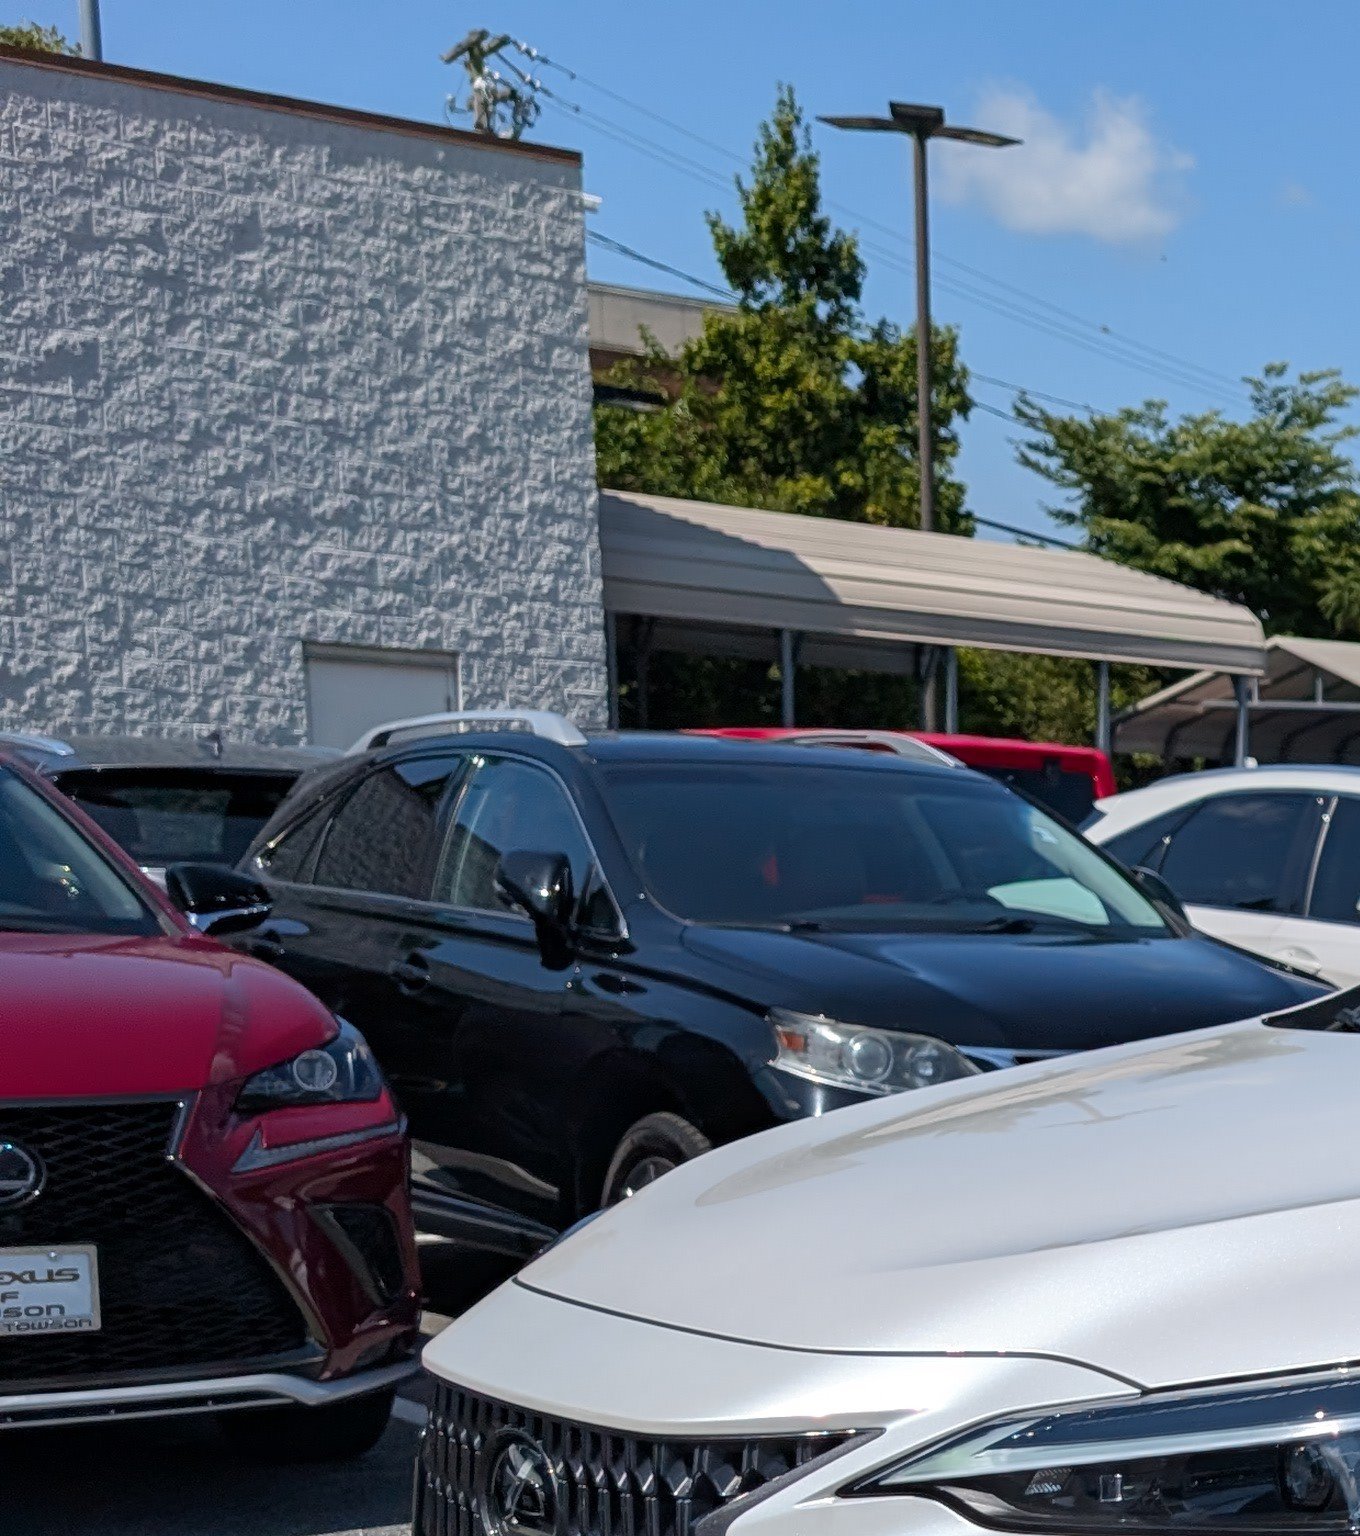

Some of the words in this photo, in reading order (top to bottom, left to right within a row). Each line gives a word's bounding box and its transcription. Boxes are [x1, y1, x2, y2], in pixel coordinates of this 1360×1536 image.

[0, 1267, 80, 1285] XUS
[0, 1291, 19, 1303] F
[2, 1304, 65, 1318] SON
